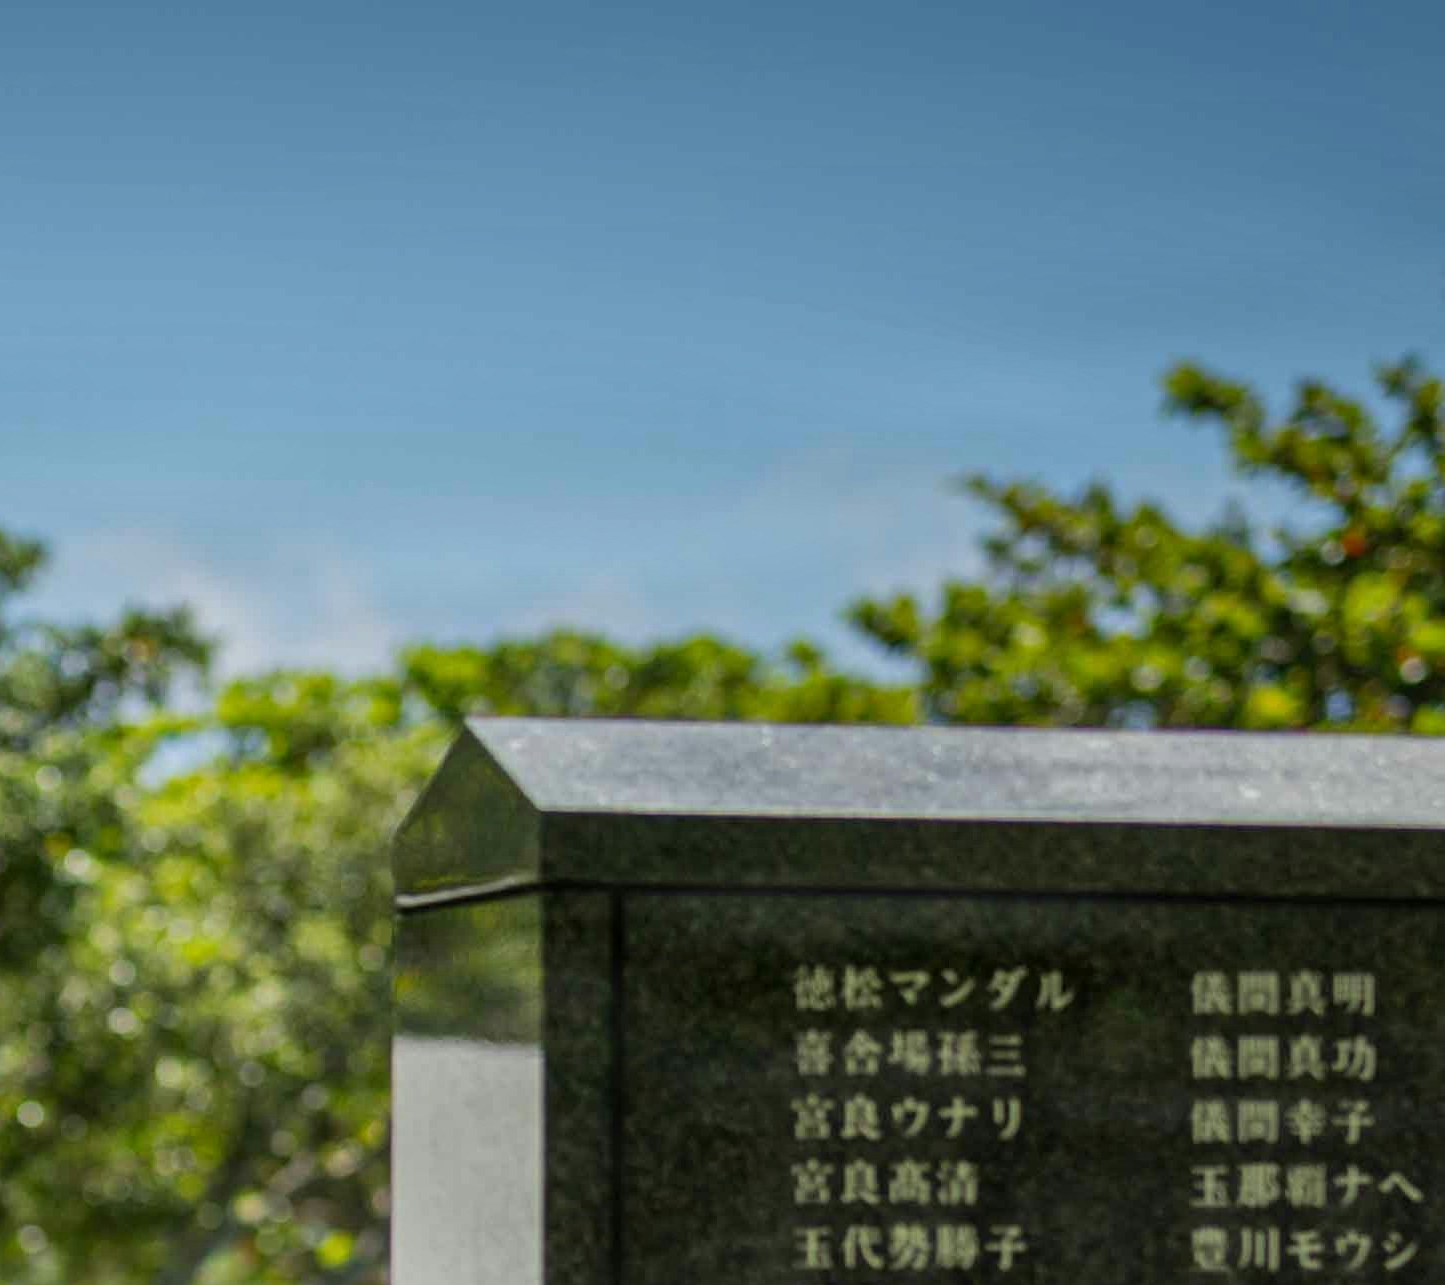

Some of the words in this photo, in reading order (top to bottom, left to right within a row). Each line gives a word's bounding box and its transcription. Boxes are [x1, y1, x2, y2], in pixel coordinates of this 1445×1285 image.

[790, 1093, 1023, 1140] 宮良ウナリ
[1190, 1099, 1375, 1145] 儀間幸子
[1190, 1226, 1418, 1272] 豊川モウシ
